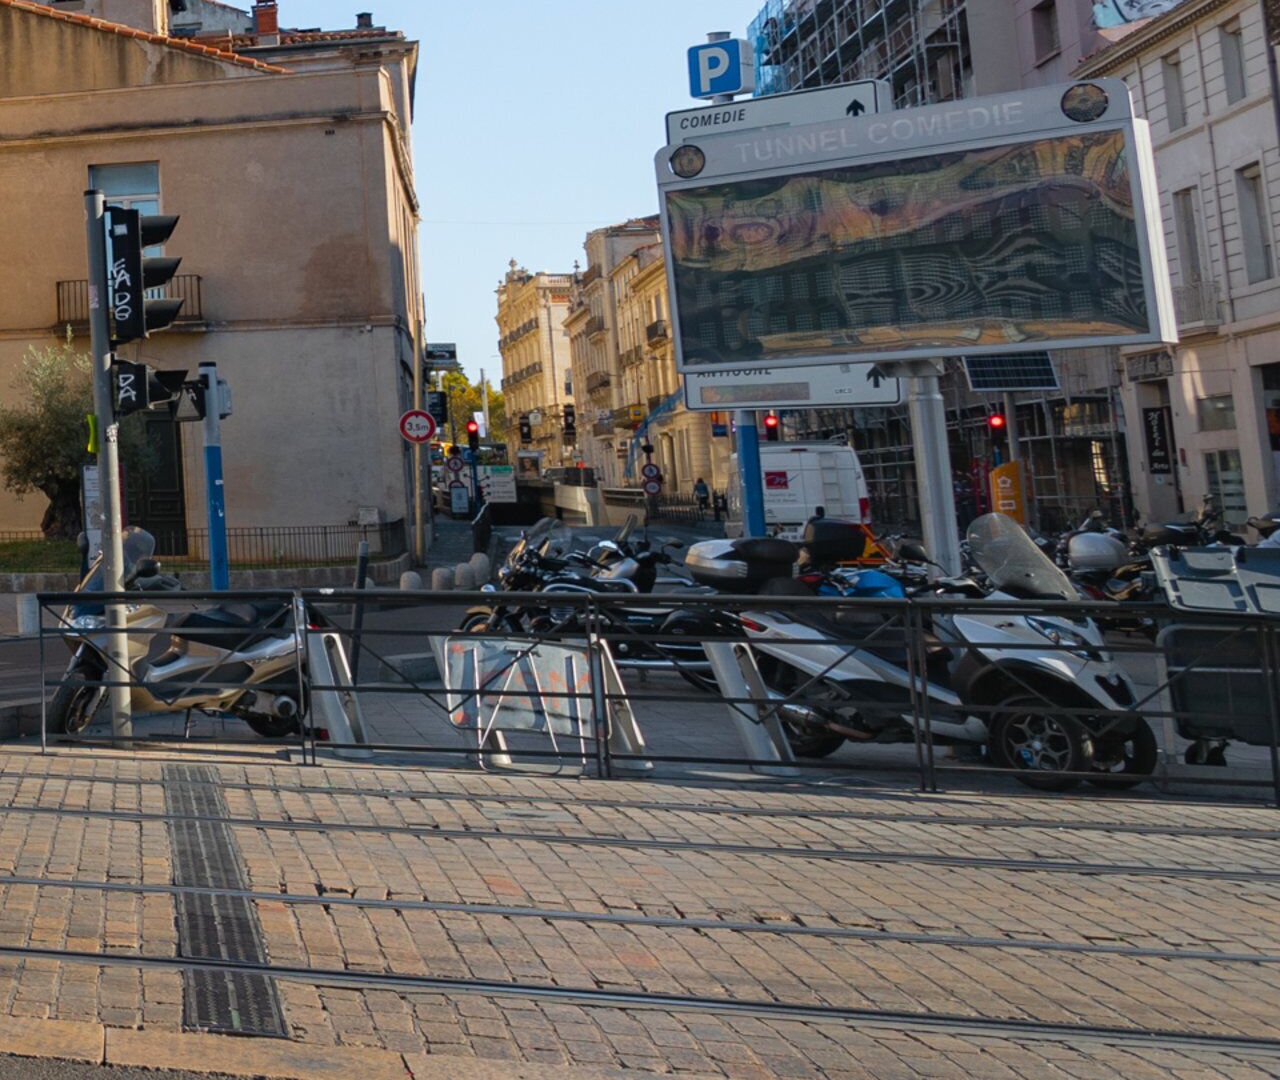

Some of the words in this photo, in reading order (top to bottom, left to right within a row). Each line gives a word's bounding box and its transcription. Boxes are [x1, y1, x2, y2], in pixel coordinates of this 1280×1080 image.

[698, 47, 730, 93] P
[680, 108, 746, 130] COMEDIE
[734, 127, 857, 163] TUNNEL
[868, 101, 1025, 144] COMEDIE
